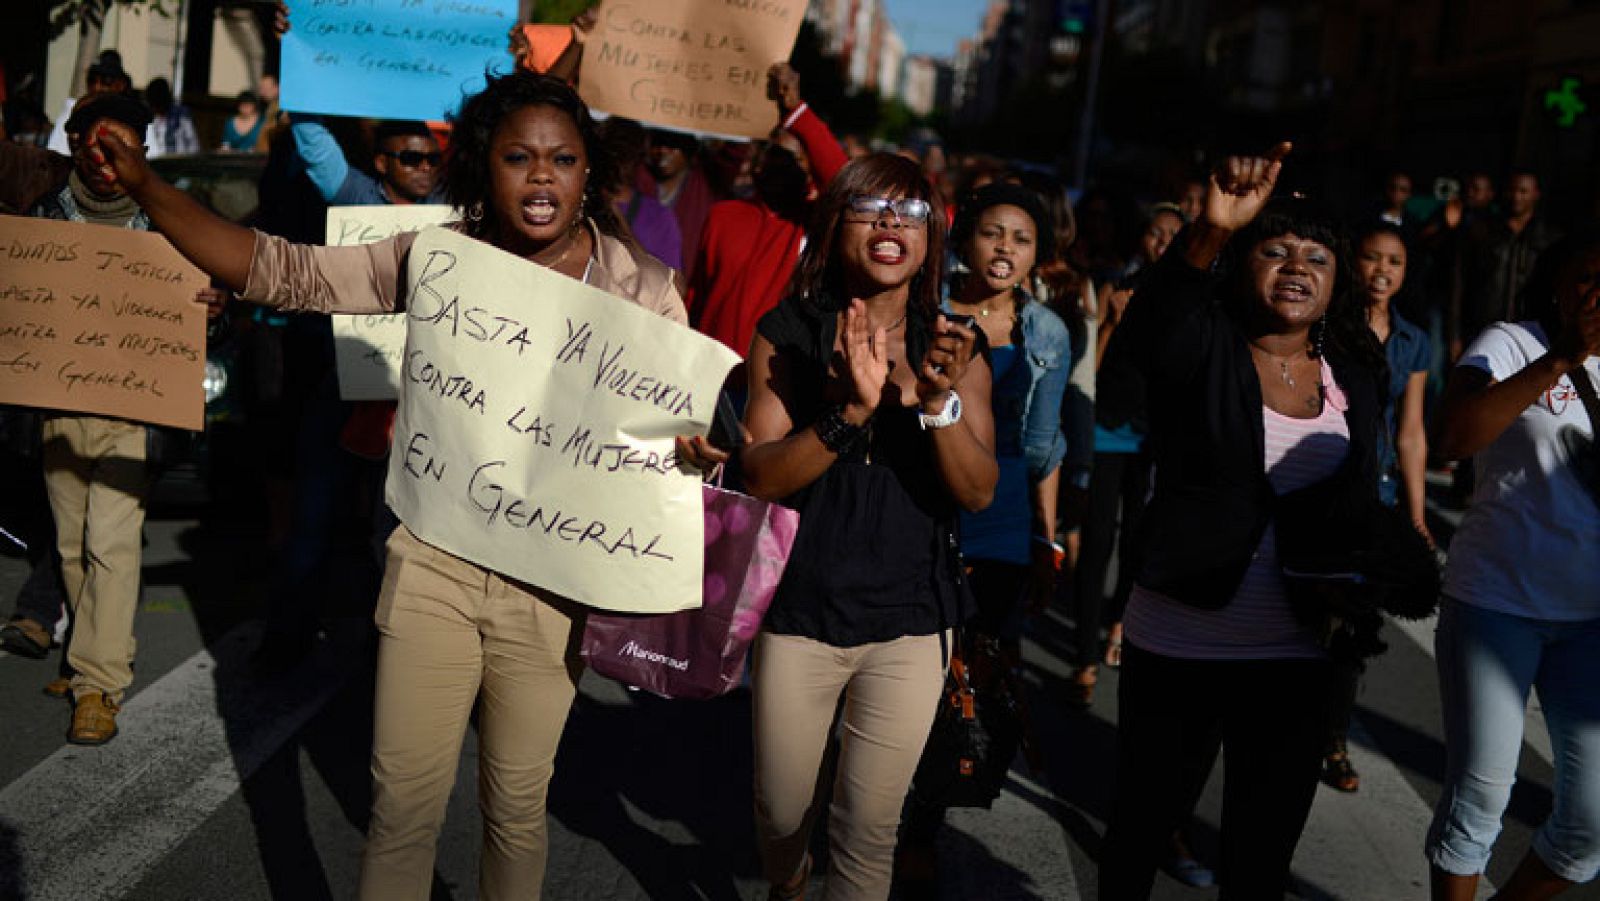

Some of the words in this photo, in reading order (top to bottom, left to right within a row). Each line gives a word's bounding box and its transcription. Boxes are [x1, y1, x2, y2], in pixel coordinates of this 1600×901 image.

[605, 3, 692, 44] CONTRA
[703, 32, 746, 53] LAS
[598, 41, 715, 81] MUJERES
[728, 66, 760, 87] EN
[96, 251, 184, 284] JUSTICIA
[71, 293, 100, 310] YA
[407, 249, 532, 356] BASTA
[555, 317, 593, 364] YA
[74, 329, 109, 347] LAS
[58, 360, 165, 398] GENERAL
[406, 350, 486, 415] CONTRA
[505, 405, 552, 447] LAS
[561, 425, 681, 475] MUJERE
[403, 432, 447, 481] EN
[467, 460, 675, 562] GENERAL
